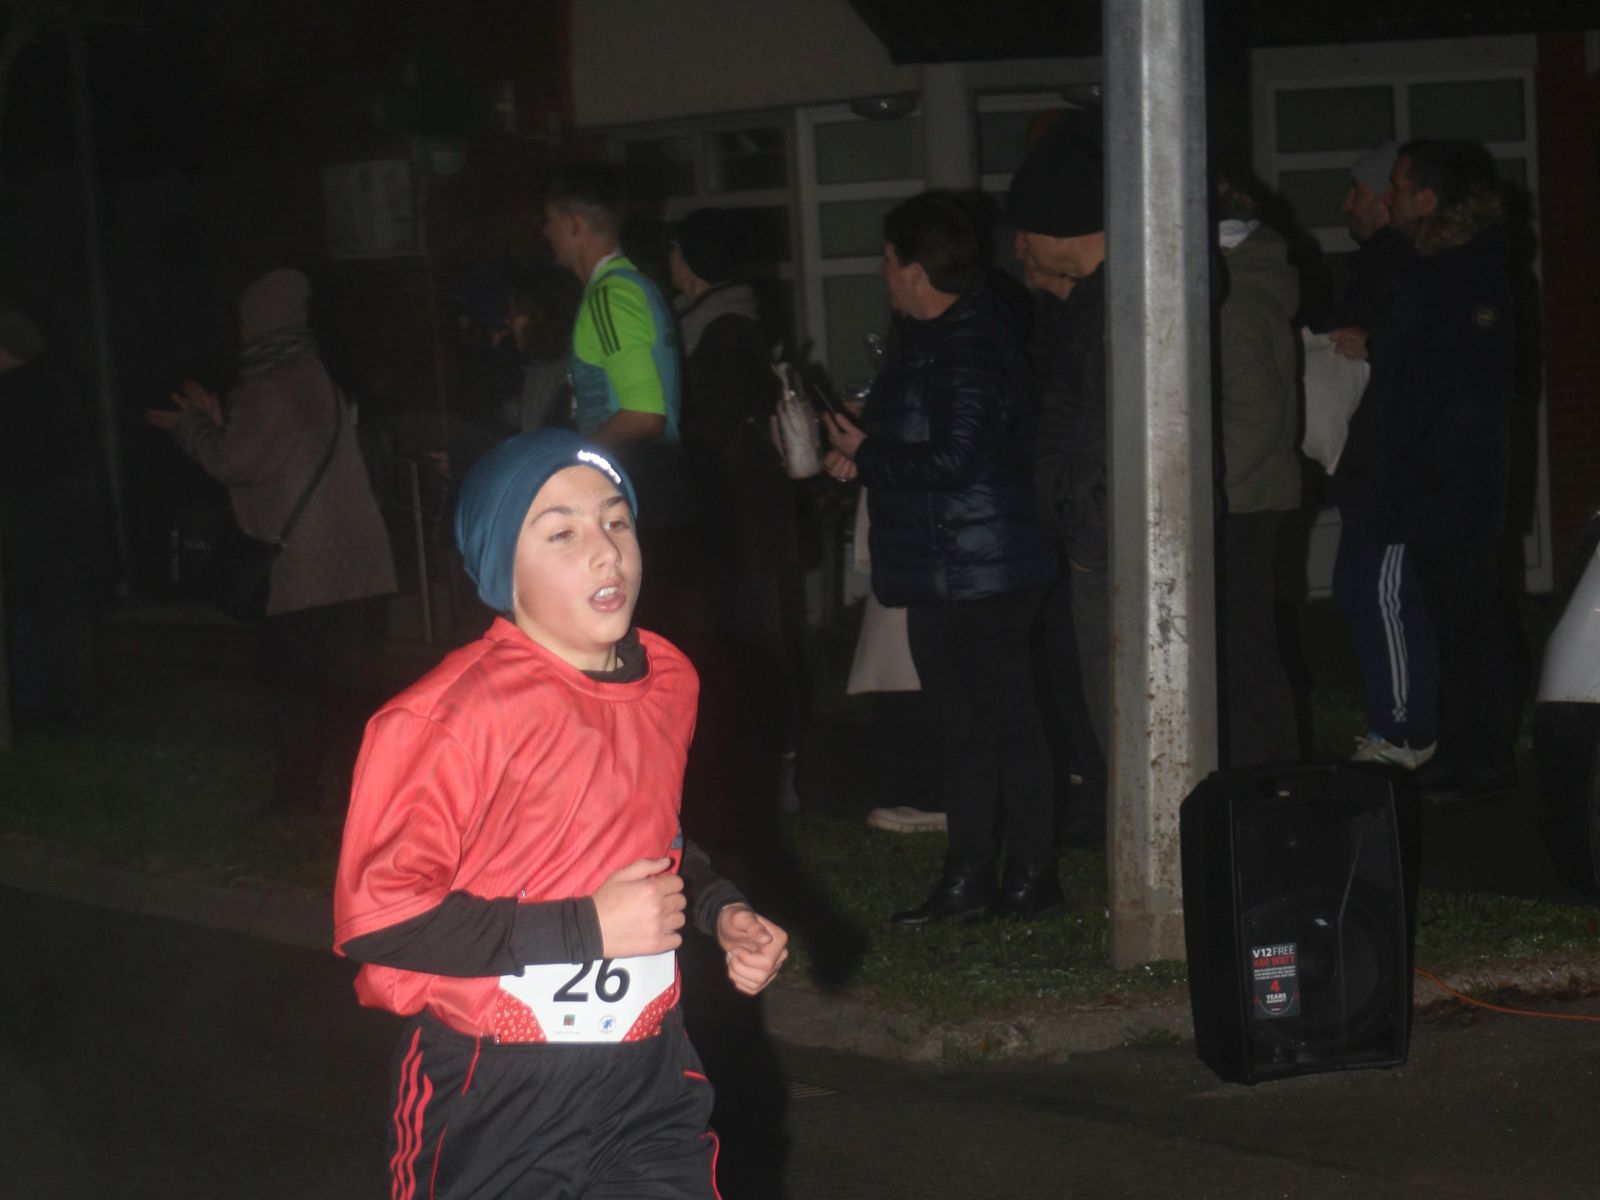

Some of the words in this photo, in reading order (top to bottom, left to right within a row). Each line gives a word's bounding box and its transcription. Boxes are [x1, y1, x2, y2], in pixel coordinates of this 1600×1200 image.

[553, 958, 630, 1003] 26
[1270, 980, 1280, 992] 4
[1266, 992, 1287, 1001] YEARS
